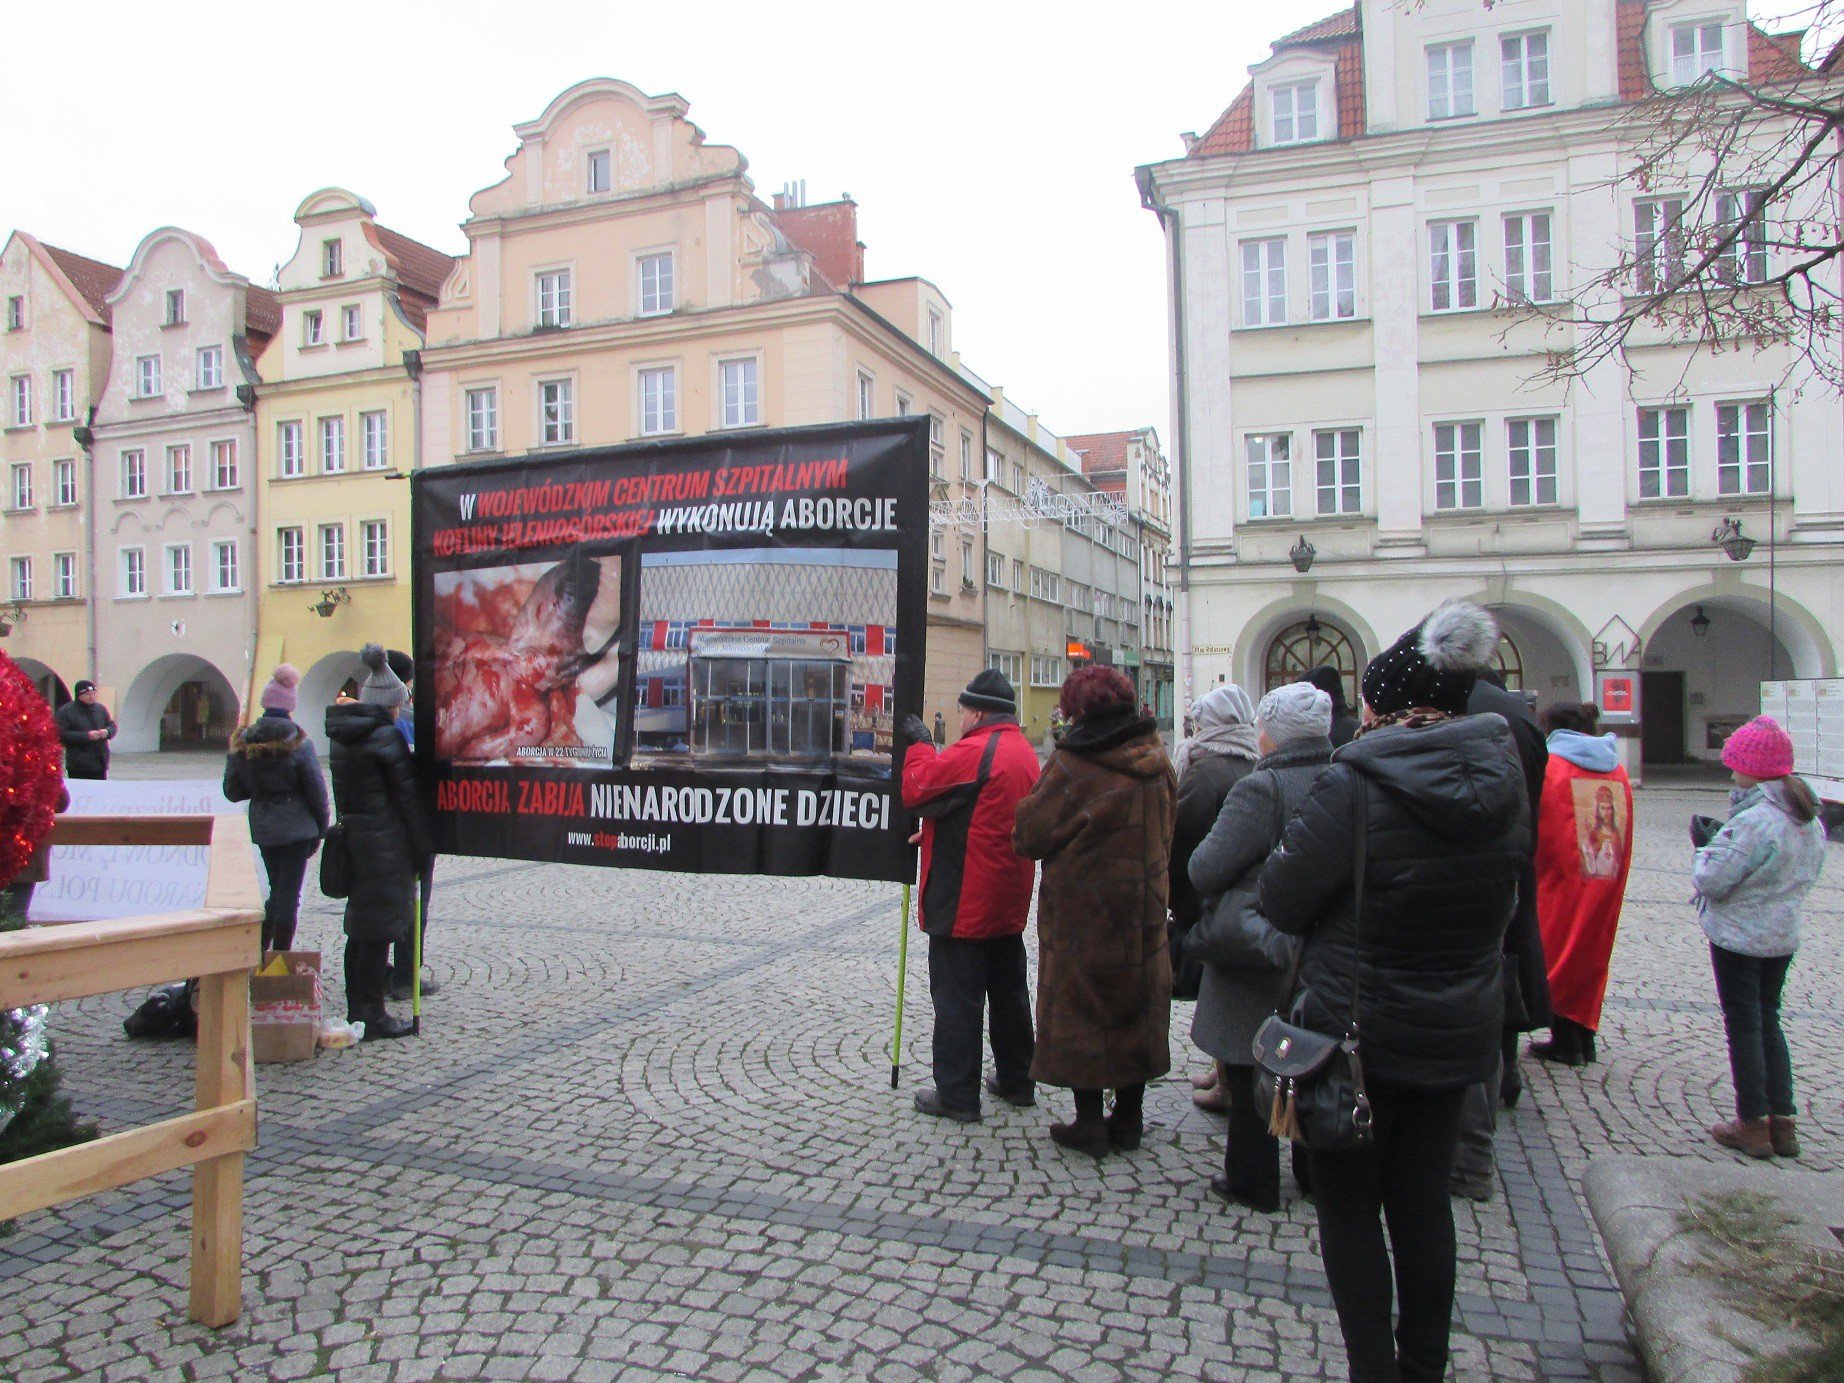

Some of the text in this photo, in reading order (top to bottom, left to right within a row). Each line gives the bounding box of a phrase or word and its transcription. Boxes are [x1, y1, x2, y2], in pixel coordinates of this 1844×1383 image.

[460, 458, 848, 521] W WOJEWÓDZKIM CENTRUM SZPITALNYM
[433, 498, 898, 557] KOTLINY JELENIOGÓRSKIEJ WYKONUJĄ ABORCJE
[516, 746, 547, 757] ABORCJA
[555, 747, 564, 757] 22
[437, 780, 890, 830] ABORCJA ZABIJA NIENARODZONE DZIECI
[568, 831, 671, 853] www.stopaborcji.pl
